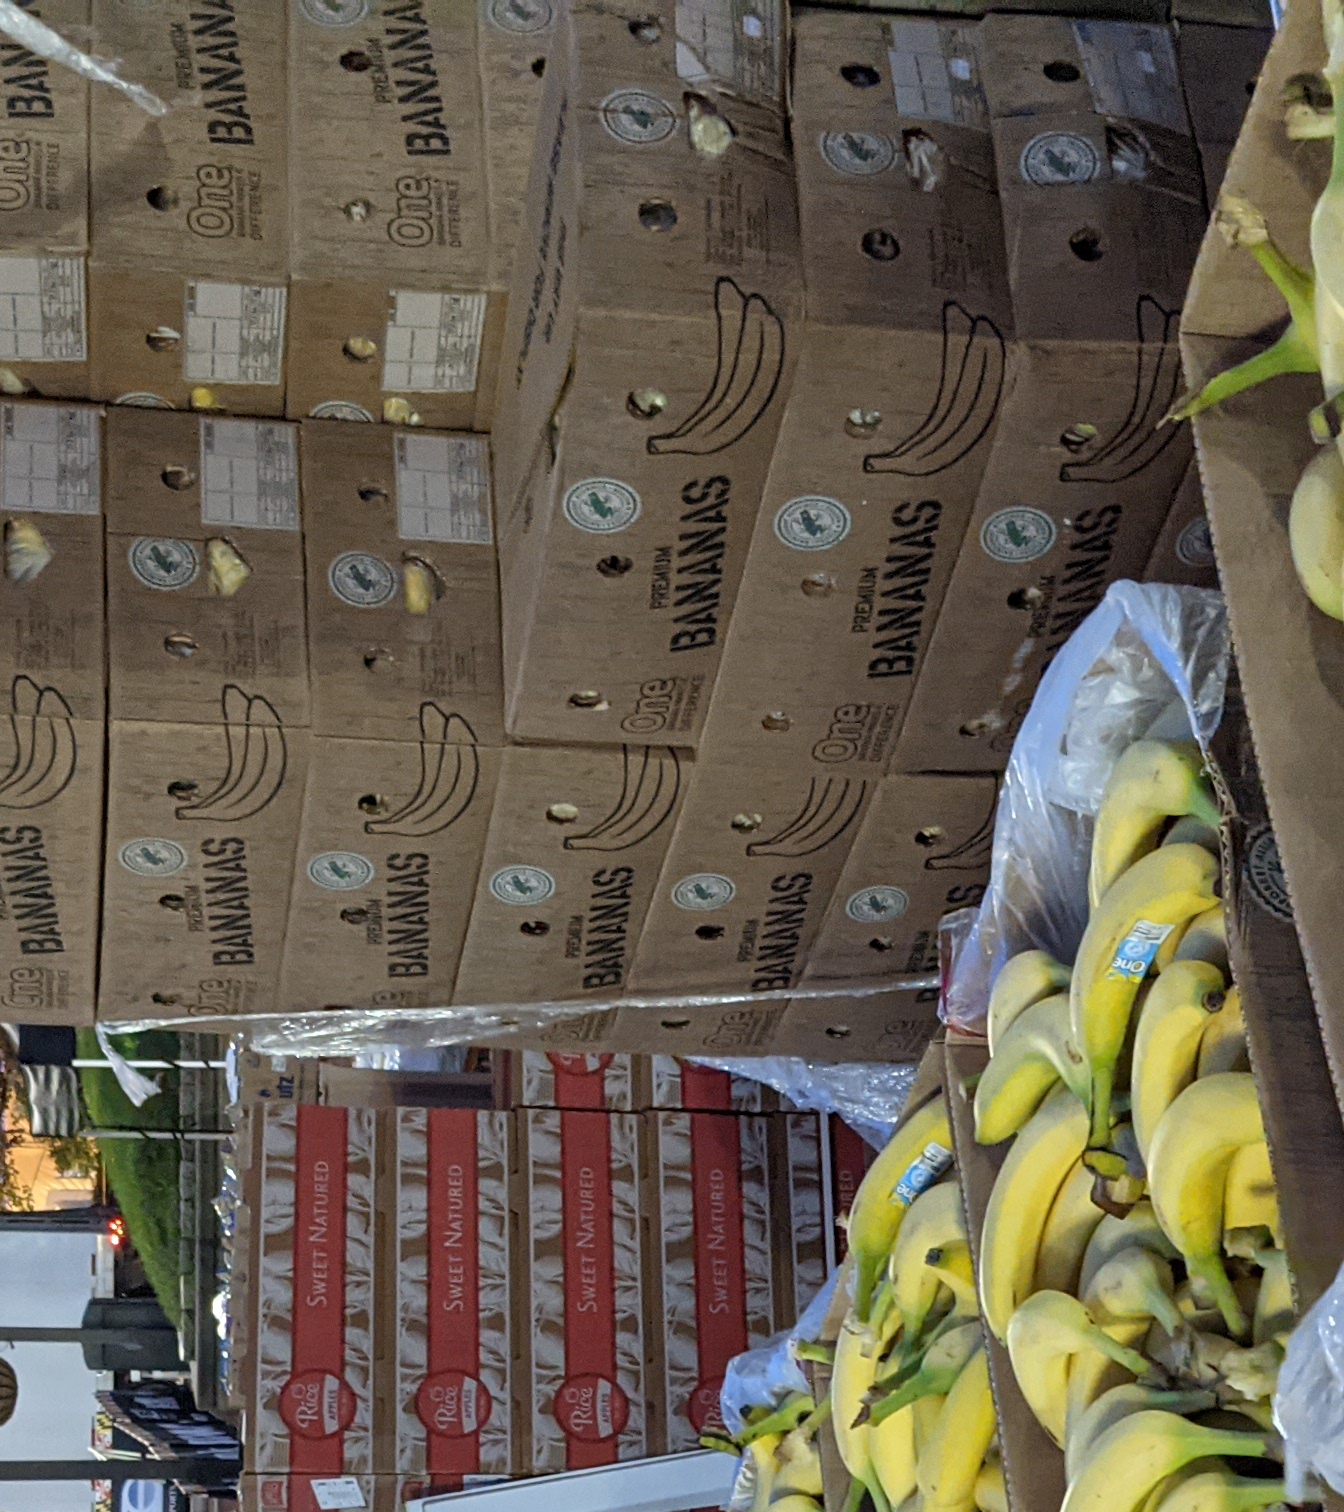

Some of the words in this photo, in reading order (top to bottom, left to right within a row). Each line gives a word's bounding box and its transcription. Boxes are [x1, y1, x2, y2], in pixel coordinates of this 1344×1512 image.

[171, 23, 194, 89] PREMIUM
[366, 38, 391, 103] PREMIUM
[186, 164, 234, 238] One
[387, 176, 433, 247] One
[649, 546, 673, 610] PREMIUM
[669, 475, 731, 653] BANANAS
[866, 499, 943, 679] BANANAS
[1040, 504, 1123, 672] NANAS
[850, 567, 879, 633] PREMIUM
[620, 677, 675, 733] One
[811, 704, 871, 763] One
[200, 836, 255, 966] BANANAS
[386, 852, 430, 977] BANANAS
[582, 867, 635, 989] BANANAS
[750, 872, 813, 992] BANANAS
[1111, 956, 1146, 973] One
[308, 1160, 329, 1243] NATURED
[443, 1163, 464, 1247] NATURED
[576, 1167, 596, 1249] NATURED
[708, 1168, 726, 1250] NATURED
[307, 1250, 328, 1307] SWEET
[443, 1254, 464, 1311] SWEET
[576, 1256, 598, 1313] SWEET
[708, 1256, 730, 1314] SWEET
[295, 1383, 320, 1428] Rice
[433, 1385, 458, 1429] Rice
[569, 1386, 594, 1432] Rice
